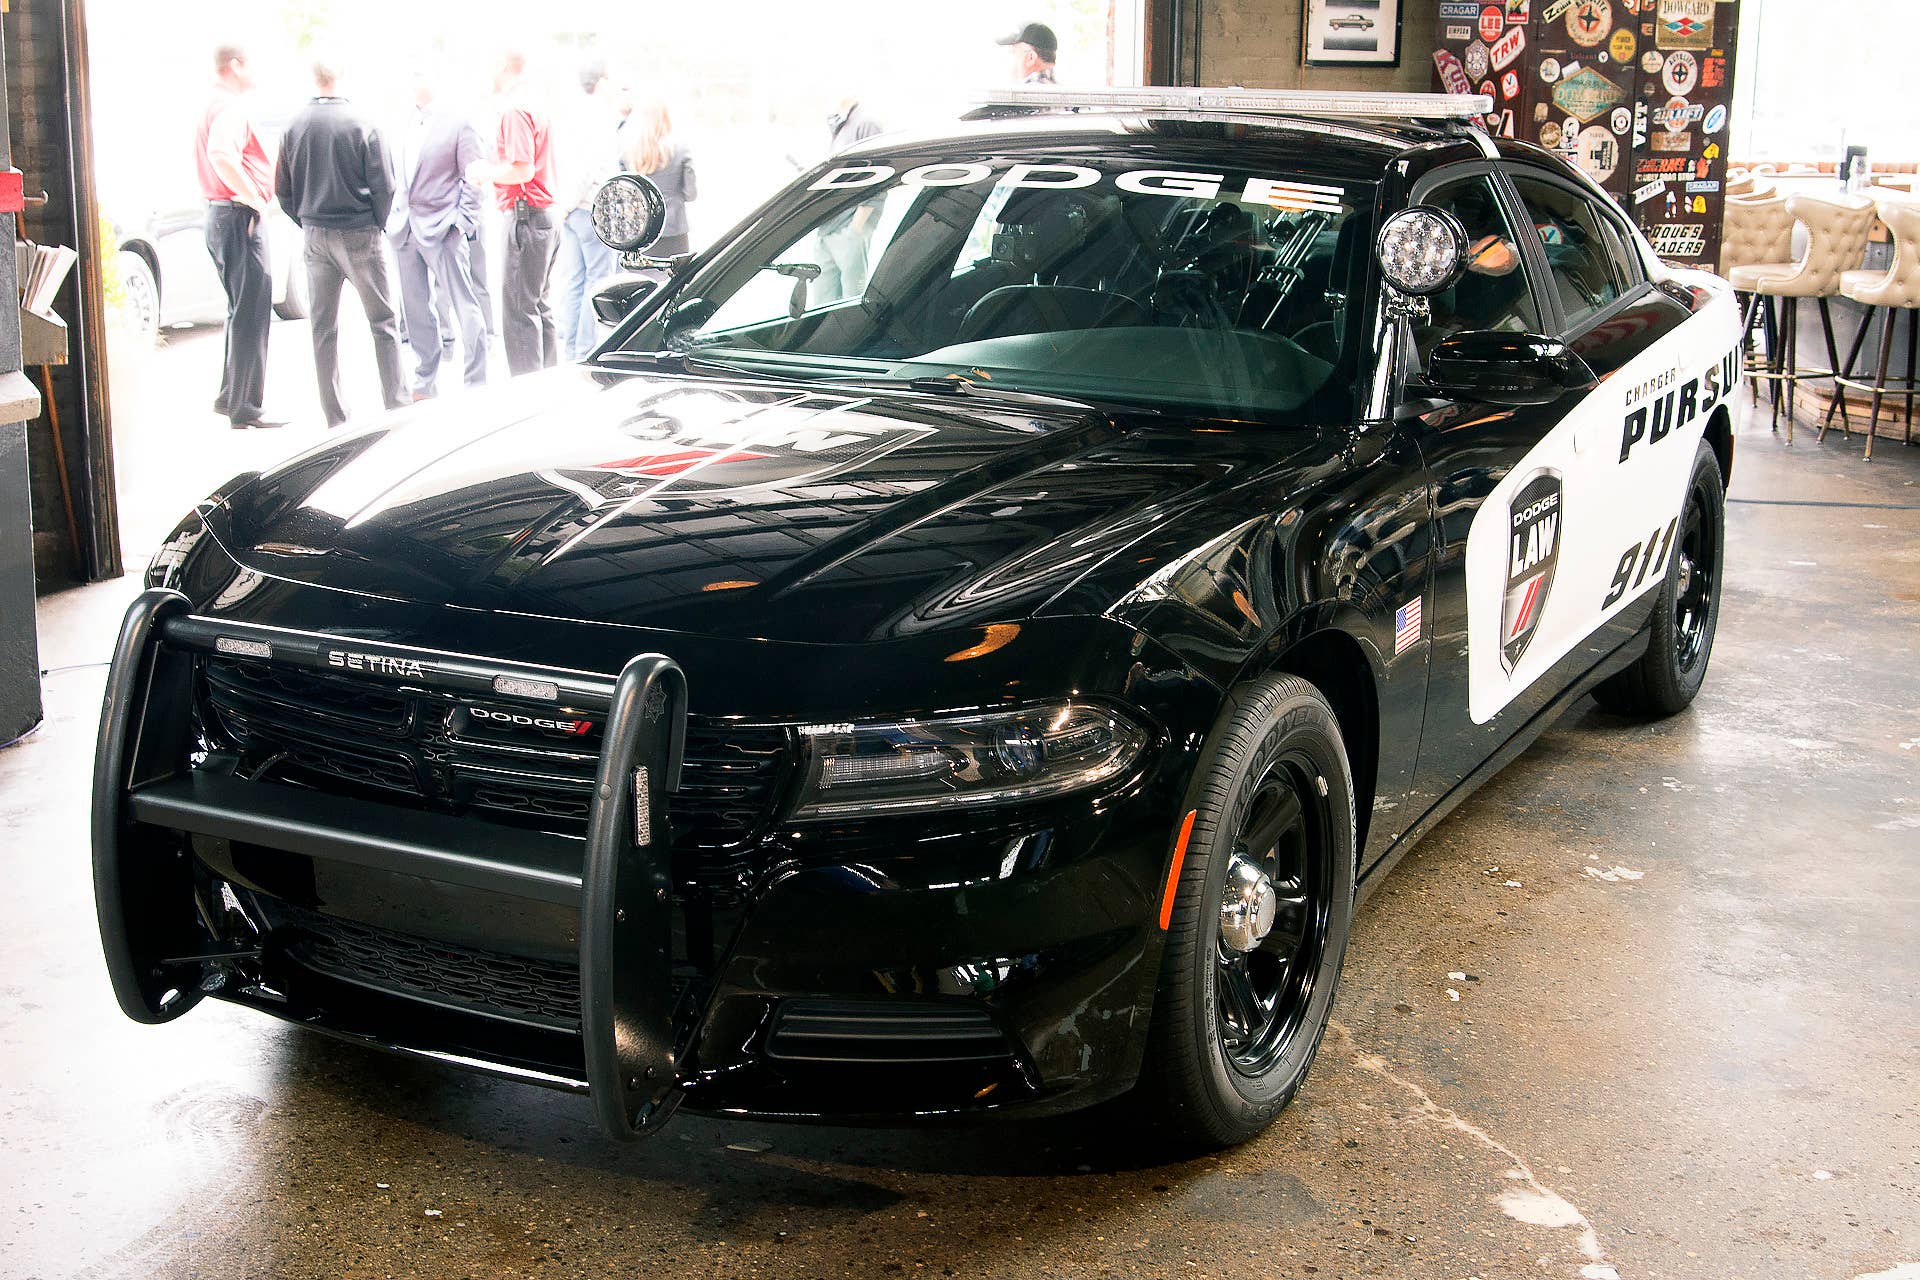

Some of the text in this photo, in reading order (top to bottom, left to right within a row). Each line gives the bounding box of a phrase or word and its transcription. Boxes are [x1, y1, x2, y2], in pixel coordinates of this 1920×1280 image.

[1442, 6, 1477, 15] CRAGAR
[1481, 17, 1501, 29] LEE
[1663, 1, 1710, 15] DOWGARD
[1493, 31, 1520, 64] TRW
[807, 163, 1345, 214] DODGE
[1652, 241, 1702, 254] EADERS
[1625, 367, 1676, 406] CHARGER
[1513, 492, 1559, 527] DODGE
[1510, 511, 1558, 579] LAW
[1601, 515, 1679, 611] 911
[328, 650, 425, 679] SETINA
[470, 708, 577, 733] DODGE
